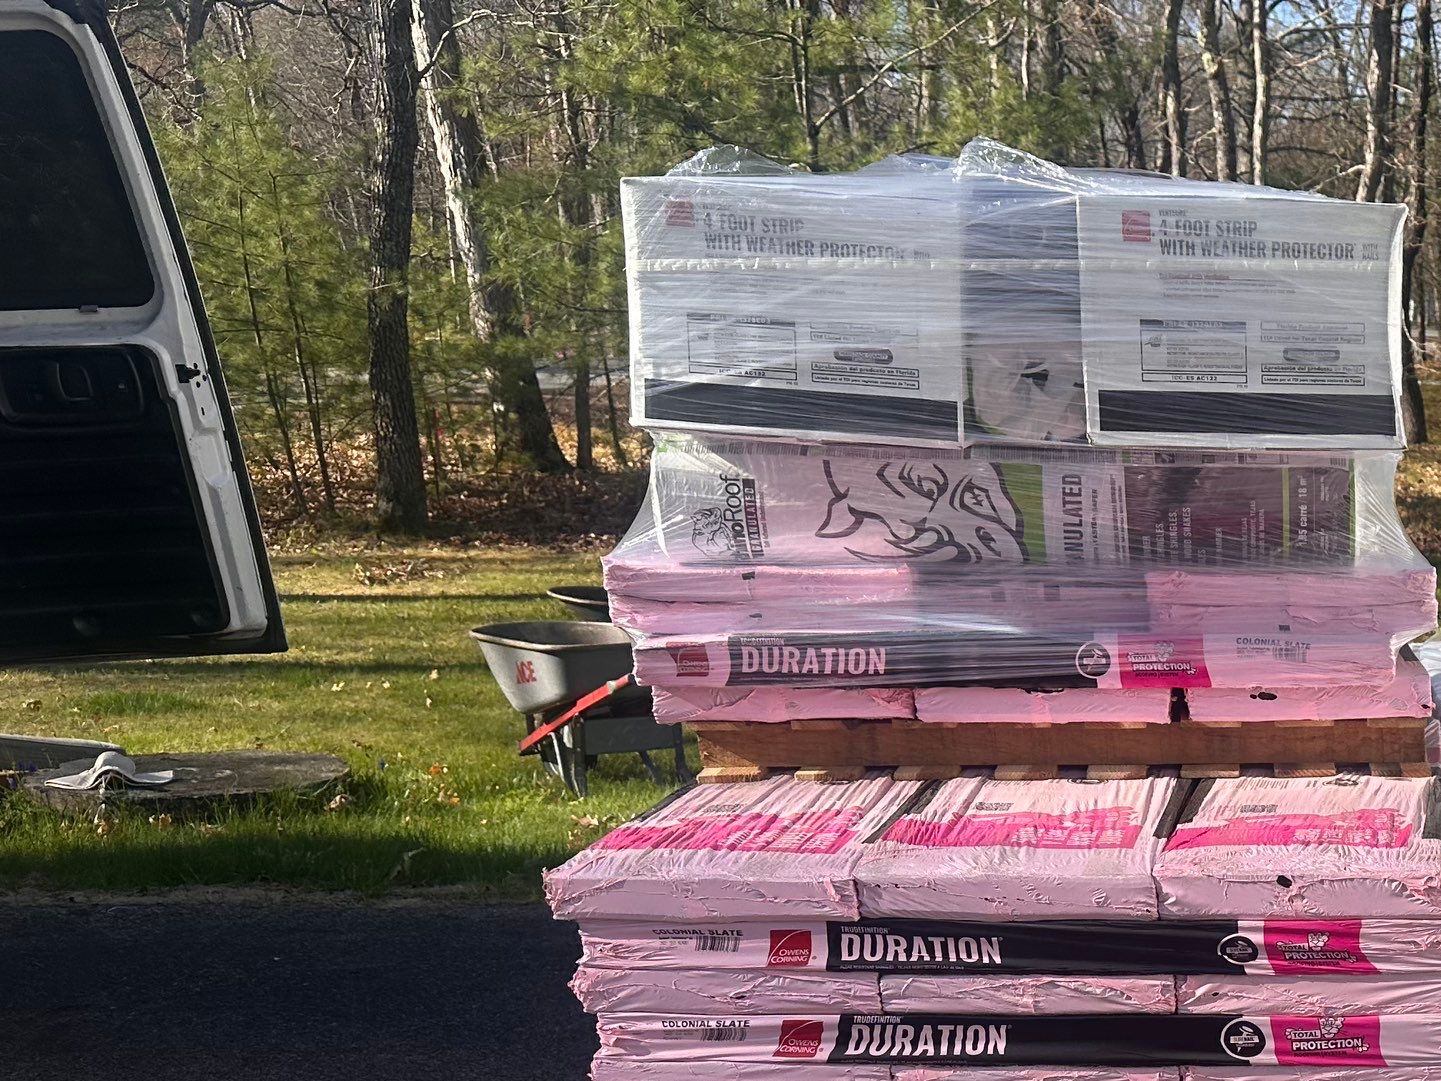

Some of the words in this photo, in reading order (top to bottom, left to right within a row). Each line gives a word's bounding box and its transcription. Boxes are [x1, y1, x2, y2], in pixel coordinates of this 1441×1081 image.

[720, 214, 756, 232] FOOT
[762, 216, 804, 233] STRIP
[1160, 220, 1168, 236] 4
[1175, 220, 1210, 236] FOOT
[1216, 220, 1257, 237] STRIP
[704, 232, 741, 250] WITH
[746, 234, 814, 256] WEATHER
[1160, 239, 1196, 256] WITH
[1200, 240, 1266, 258] WEATHER
[1272, 242, 1354, 260] PROTECTOR
[1298, 488, 1307, 497] 18
[1062, 474, 1085, 565] ANULATED
[1236, 637, 1281, 647] COLONIAL
[1284, 641, 1311, 650] SLATE
[742, 646, 886, 676] DURATION
[1133, 662, 1190, 672] PROTECTION
[516, 660, 536, 684] ACE
[840, 933, 1002, 964] DURATION
[1286, 951, 1348, 960] PROTECTION
[844, 1024, 1007, 1057] DURATION
[1292, 1039, 1362, 1050] PROTECTION
